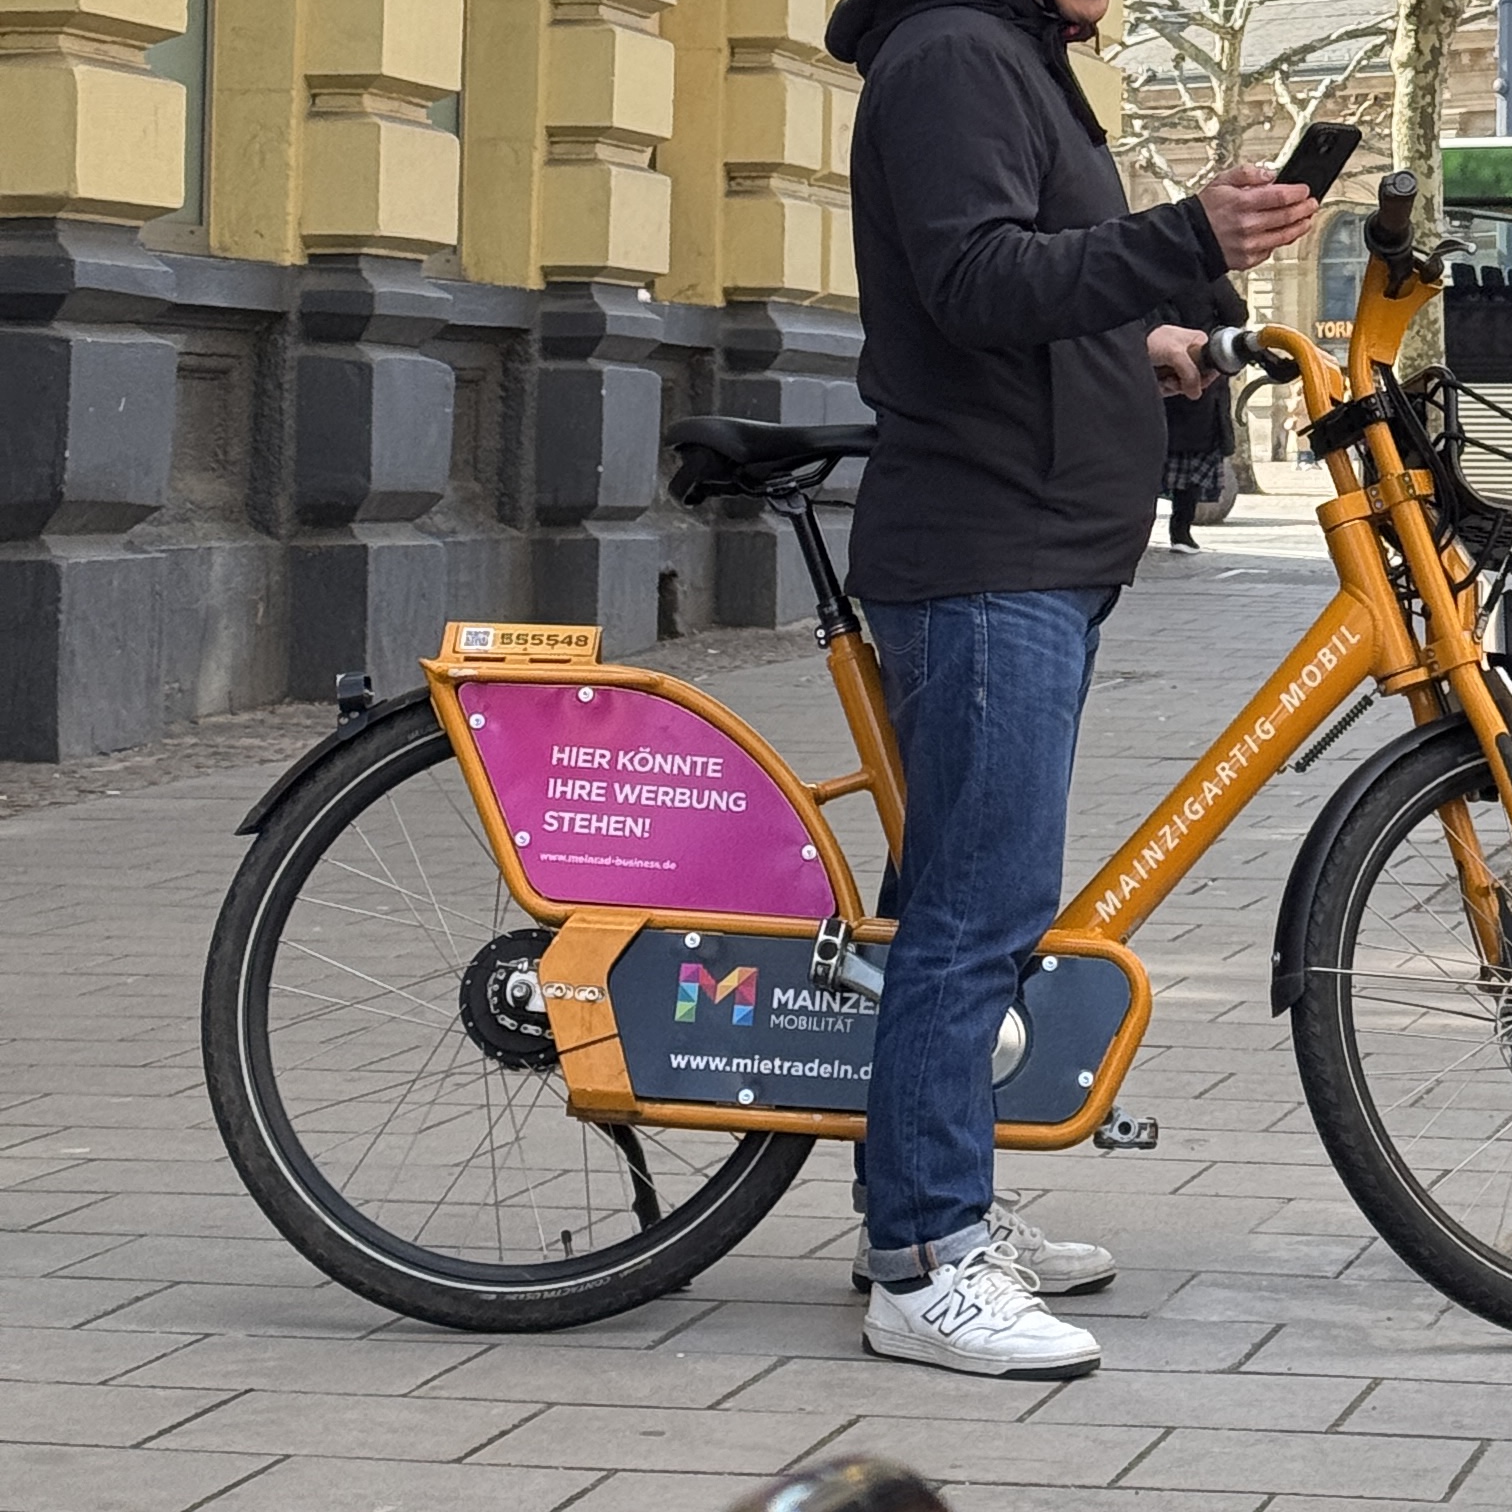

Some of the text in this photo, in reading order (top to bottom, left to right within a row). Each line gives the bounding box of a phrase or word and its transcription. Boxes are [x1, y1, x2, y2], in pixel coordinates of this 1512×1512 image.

[500, 633, 589, 647] 555548
[1279, 625, 1361, 714] MOBIL
[551, 745, 724, 777] HIER KÖNNTE
[547, 778, 747, 812] IHRE WERBUNG
[542, 811, 651, 838] STEHEN!
[1094, 716, 1276, 923] MAINZIGARTIG
[771, 987, 880, 1015] MAINZE
[769, 1014, 854, 1033] MOBILITÄT
